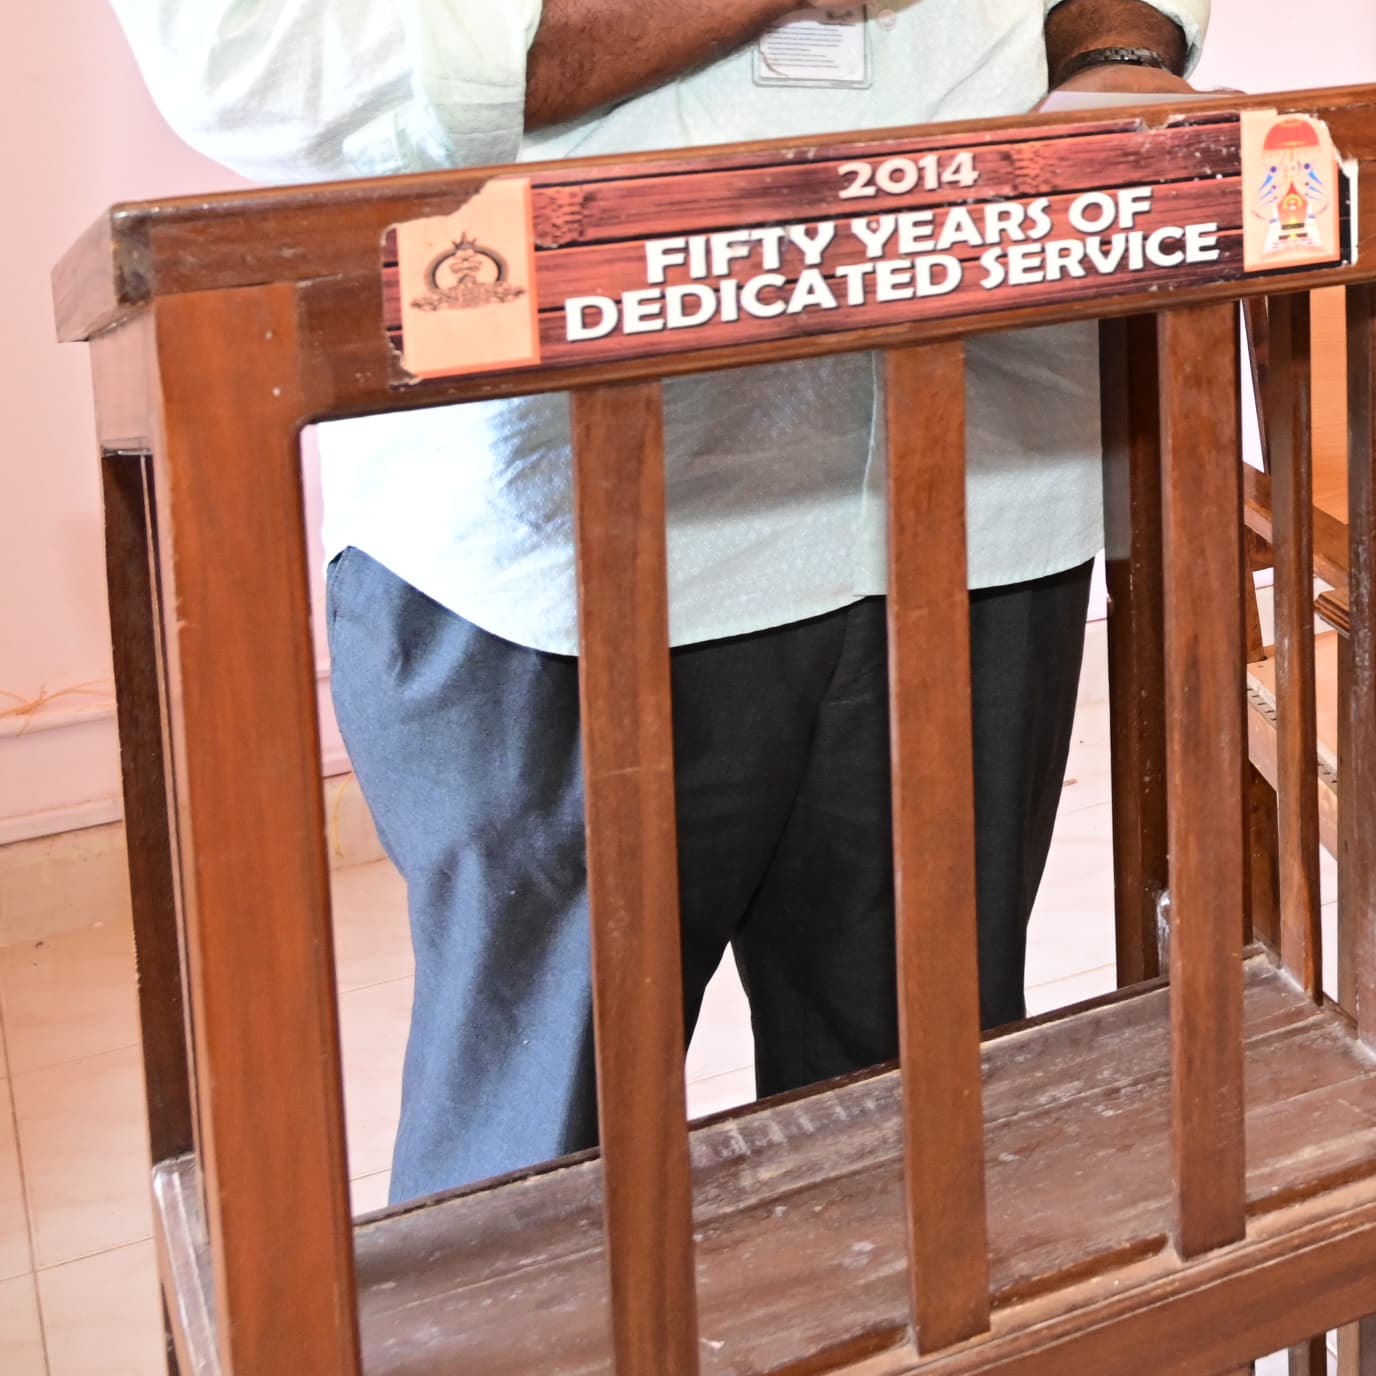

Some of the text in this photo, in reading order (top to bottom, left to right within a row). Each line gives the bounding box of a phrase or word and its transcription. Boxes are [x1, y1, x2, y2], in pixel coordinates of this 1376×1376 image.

[838, 152, 980, 199] 2014
[564, 222, 1220, 343] DEDICATED SERVICE
[645, 186, 1153, 284] FIFTY YEARS OF
